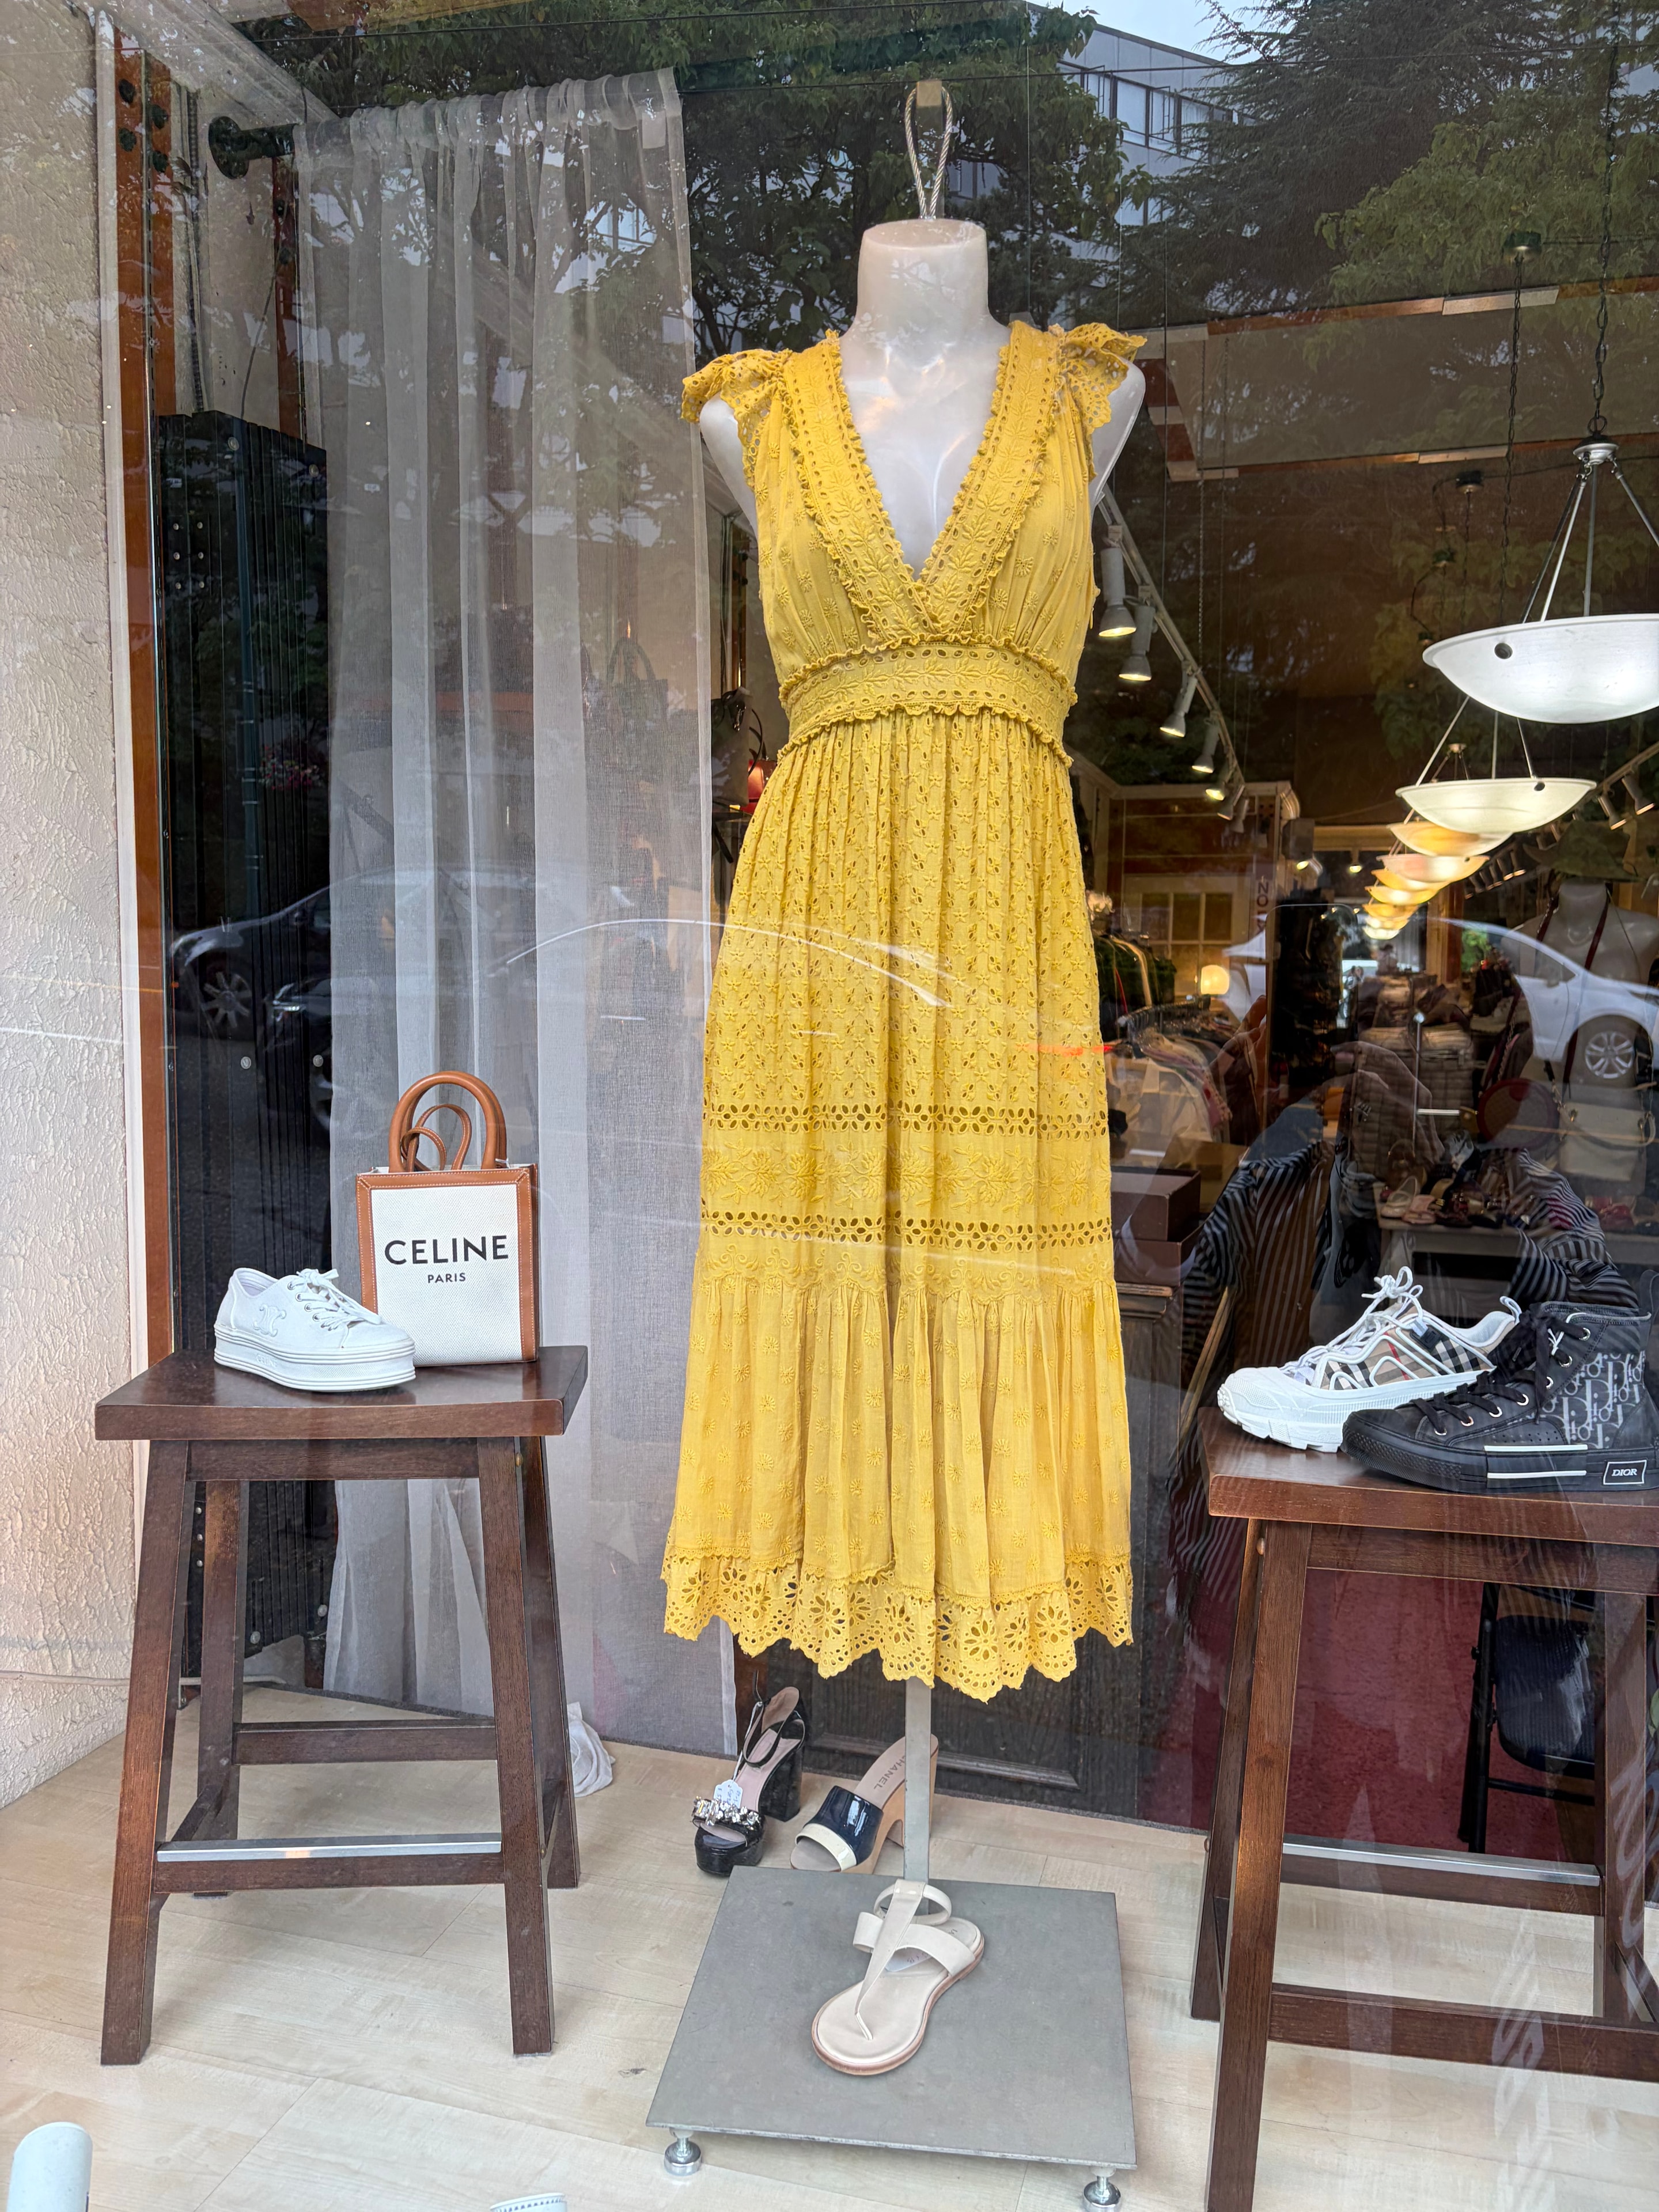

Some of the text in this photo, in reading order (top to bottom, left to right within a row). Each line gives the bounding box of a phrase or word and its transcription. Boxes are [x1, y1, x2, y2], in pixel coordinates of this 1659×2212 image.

[384, 1235, 509, 1265] CELINE
[427, 1272, 466, 1283] PARIS
[1611, 1468, 1638, 1476] DIOR
